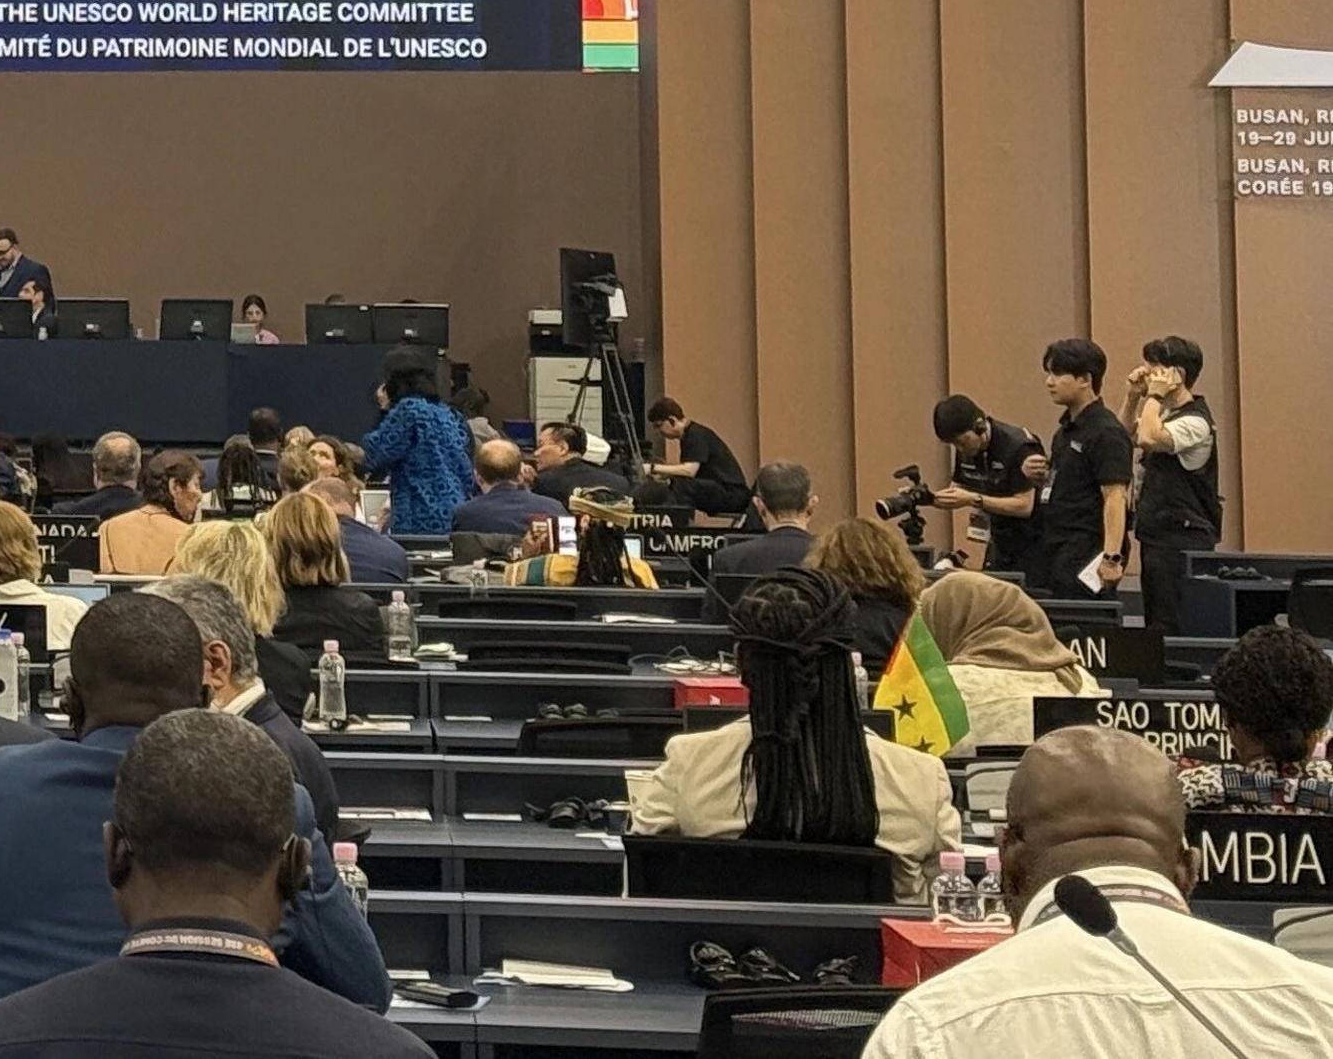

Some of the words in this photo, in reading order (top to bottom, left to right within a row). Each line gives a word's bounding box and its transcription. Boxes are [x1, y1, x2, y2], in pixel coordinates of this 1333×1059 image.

[43, 3, 133, 23] UNESCO
[138, 3, 217, 23] WORLD
[223, 3, 332, 23] HERITAGE
[337, 3, 475, 23] COMMITTEE
[56, 38, 87, 58] DU
[92, 38, 228, 58] PATRIMOINE
[234, 38, 339, 58] MONDIAL
[343, 38, 373, 58] DE
[378, 38, 488, 58] L'UNESCO
[1236, 109, 1310, 126] BUSAN,
[1237, 158, 1310, 176] BUSAN,
[1237, 177, 1304, 196] CORÉE
[36, 524, 88, 537] NADA
[631, 514, 673, 529] TRIA
[1096, 701, 1150, 730] SAO
[1164, 703, 1228, 730] TOM
[1200, 830, 1327, 886] MBIA
